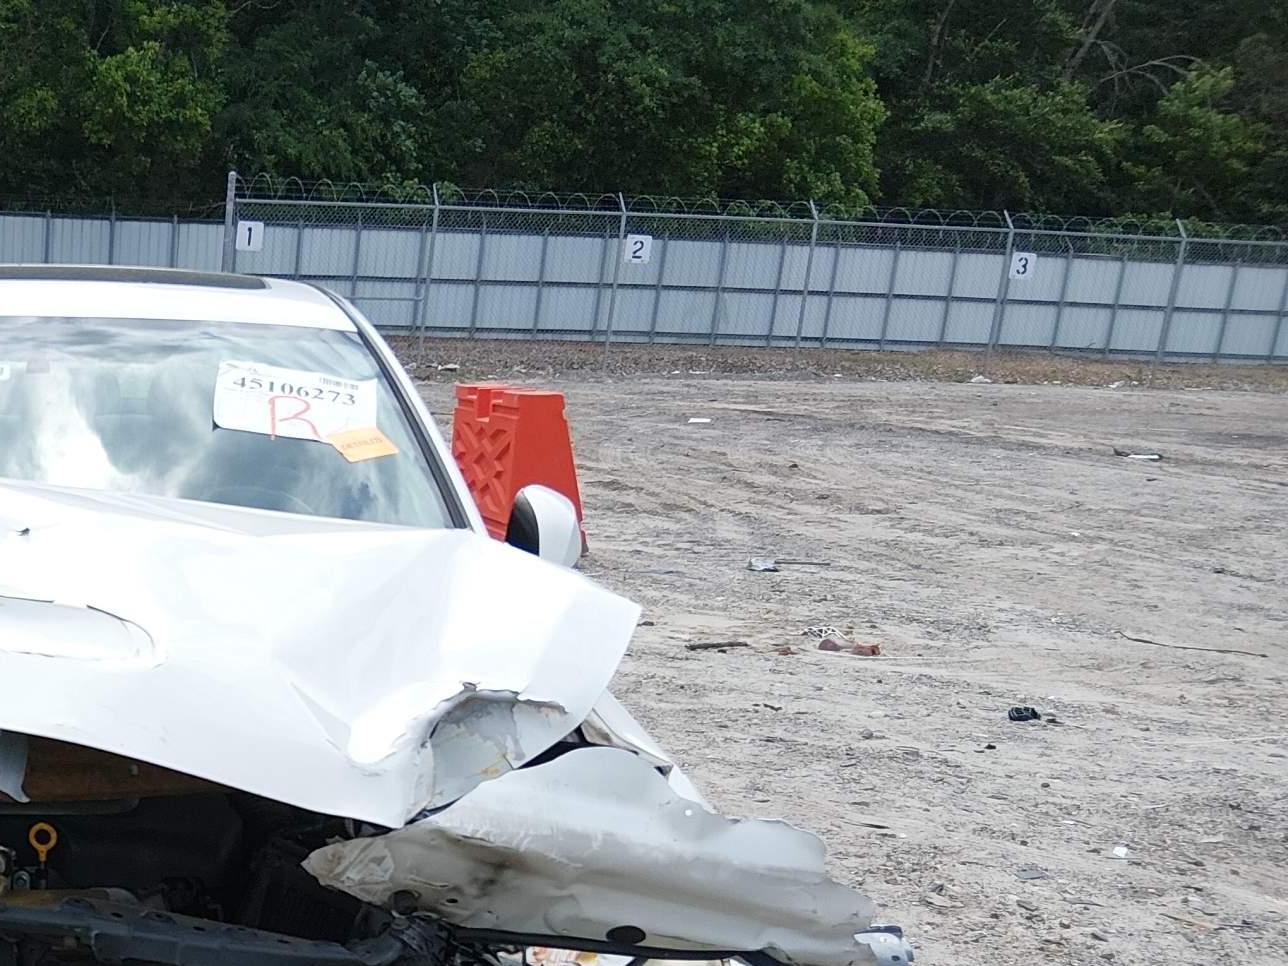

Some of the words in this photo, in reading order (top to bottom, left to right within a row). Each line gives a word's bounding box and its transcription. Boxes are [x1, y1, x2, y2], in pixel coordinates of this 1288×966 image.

[247, 226, 253, 247] 1
[631, 240, 644, 259] 2
[1015, 257, 1029, 275] 3
[232, 375, 357, 407] 45106273
[268, 395, 327, 440] R
